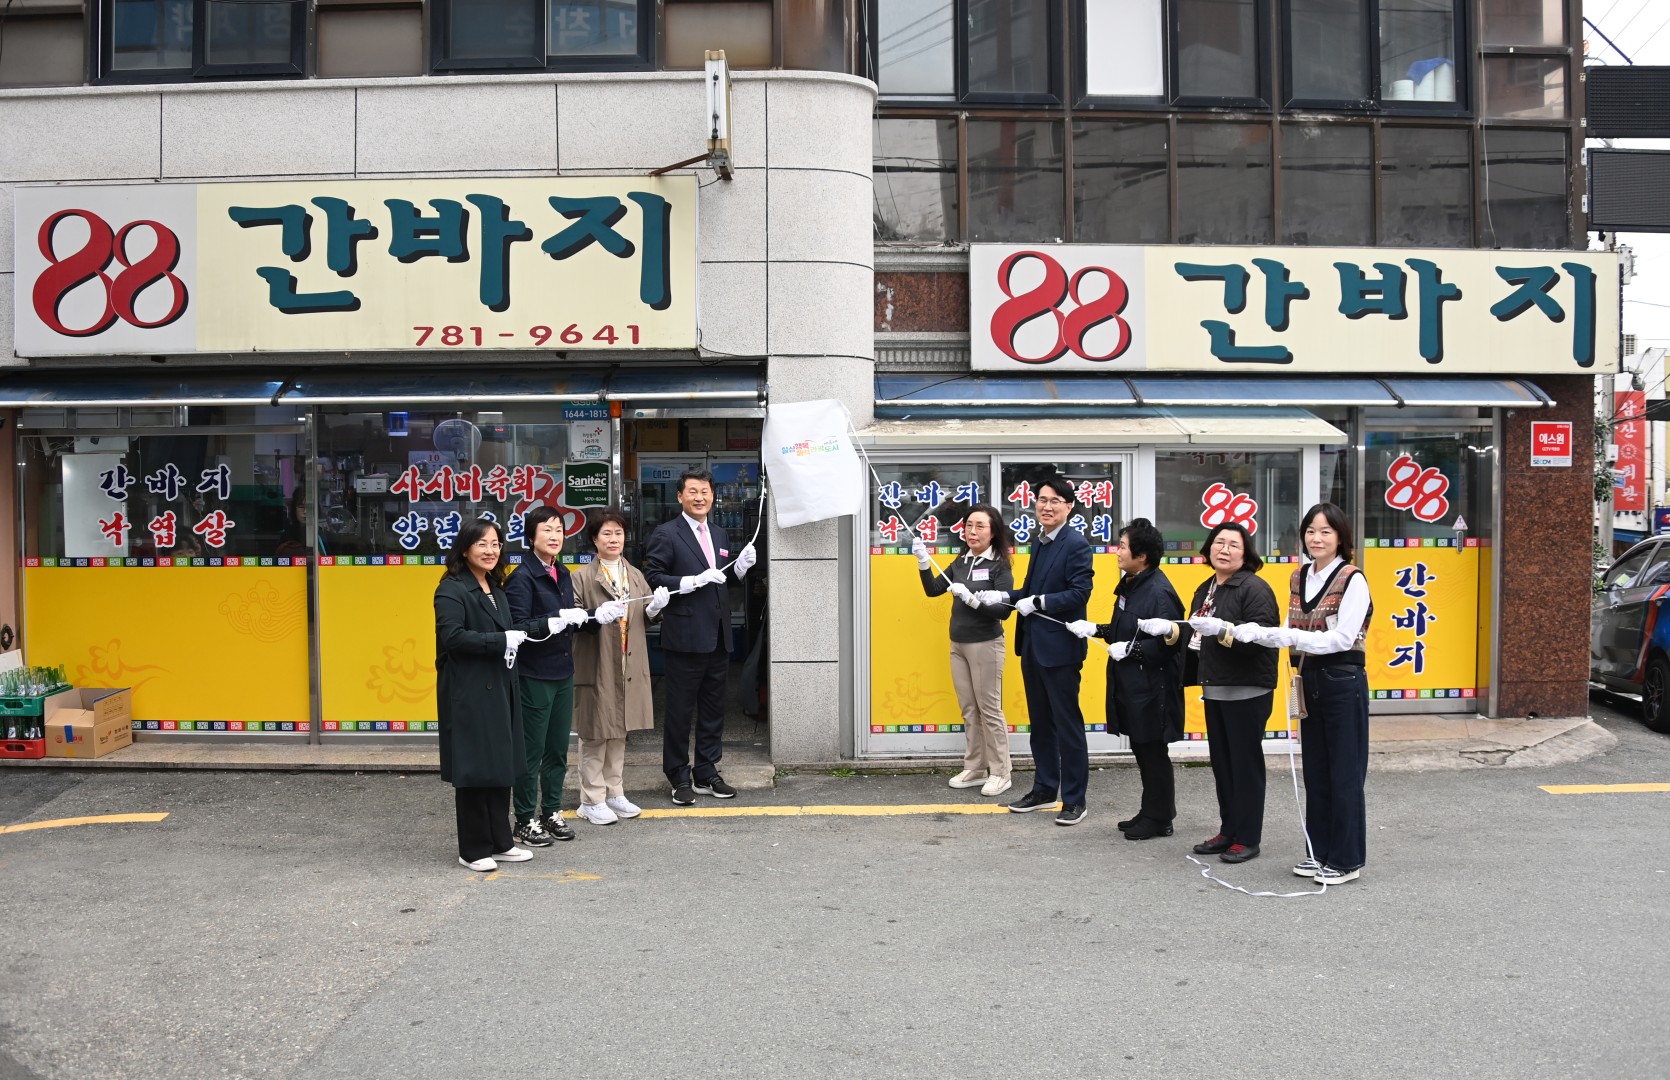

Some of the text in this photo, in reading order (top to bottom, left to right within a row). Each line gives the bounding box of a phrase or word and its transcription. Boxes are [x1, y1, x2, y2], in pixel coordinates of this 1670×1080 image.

[32, 191, 672, 336] 88 간바지
[990, 250, 1597, 367] 88 간바지
[564, 409, 608, 418] 1644-1815
[1539, 433, 1565, 444] 에스원
[99, 463, 231, 501] 간바지
[390, 464, 537, 502] 사시미육회
[568, 475, 607, 486] Sanitec
[878, 480, 979, 508] 간바지
[1008, 480, 1114, 508] 사육회
[1385, 454, 1450, 523] 88
[1200, 482, 1258, 536] 88
[98, 510, 235, 547] 낙엽살
[392, 511, 531, 550] 양념회
[1010, 514, 1113, 543] 양육회
[1388, 562, 1438, 674] 간바지
